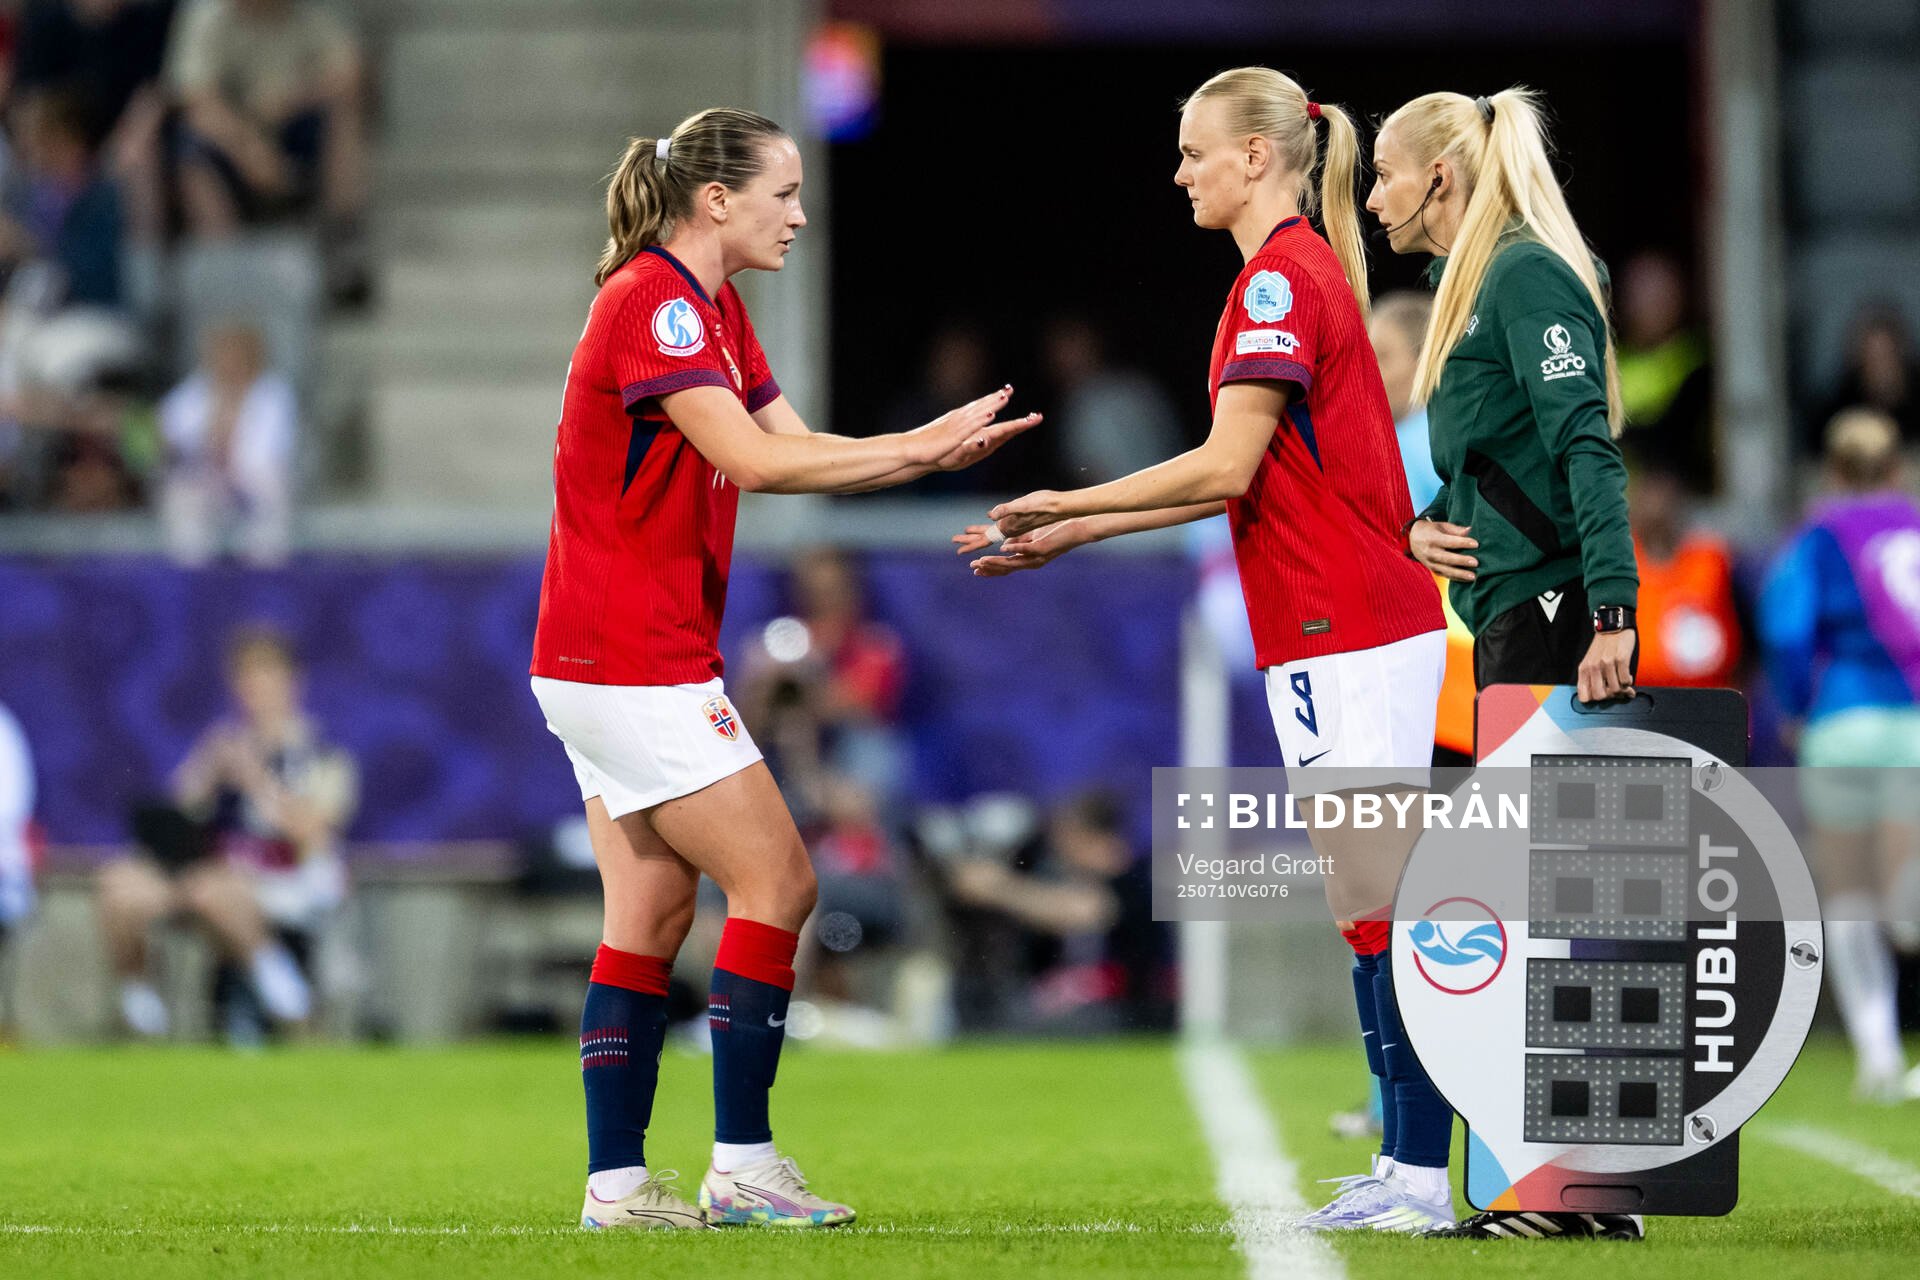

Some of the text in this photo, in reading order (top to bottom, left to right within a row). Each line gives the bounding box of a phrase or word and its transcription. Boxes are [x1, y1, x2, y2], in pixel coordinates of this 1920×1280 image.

[1275, 335, 1291, 347] 10
[1290, 671, 1319, 737] 9
[1694, 834, 1739, 1073] HUBLOT
